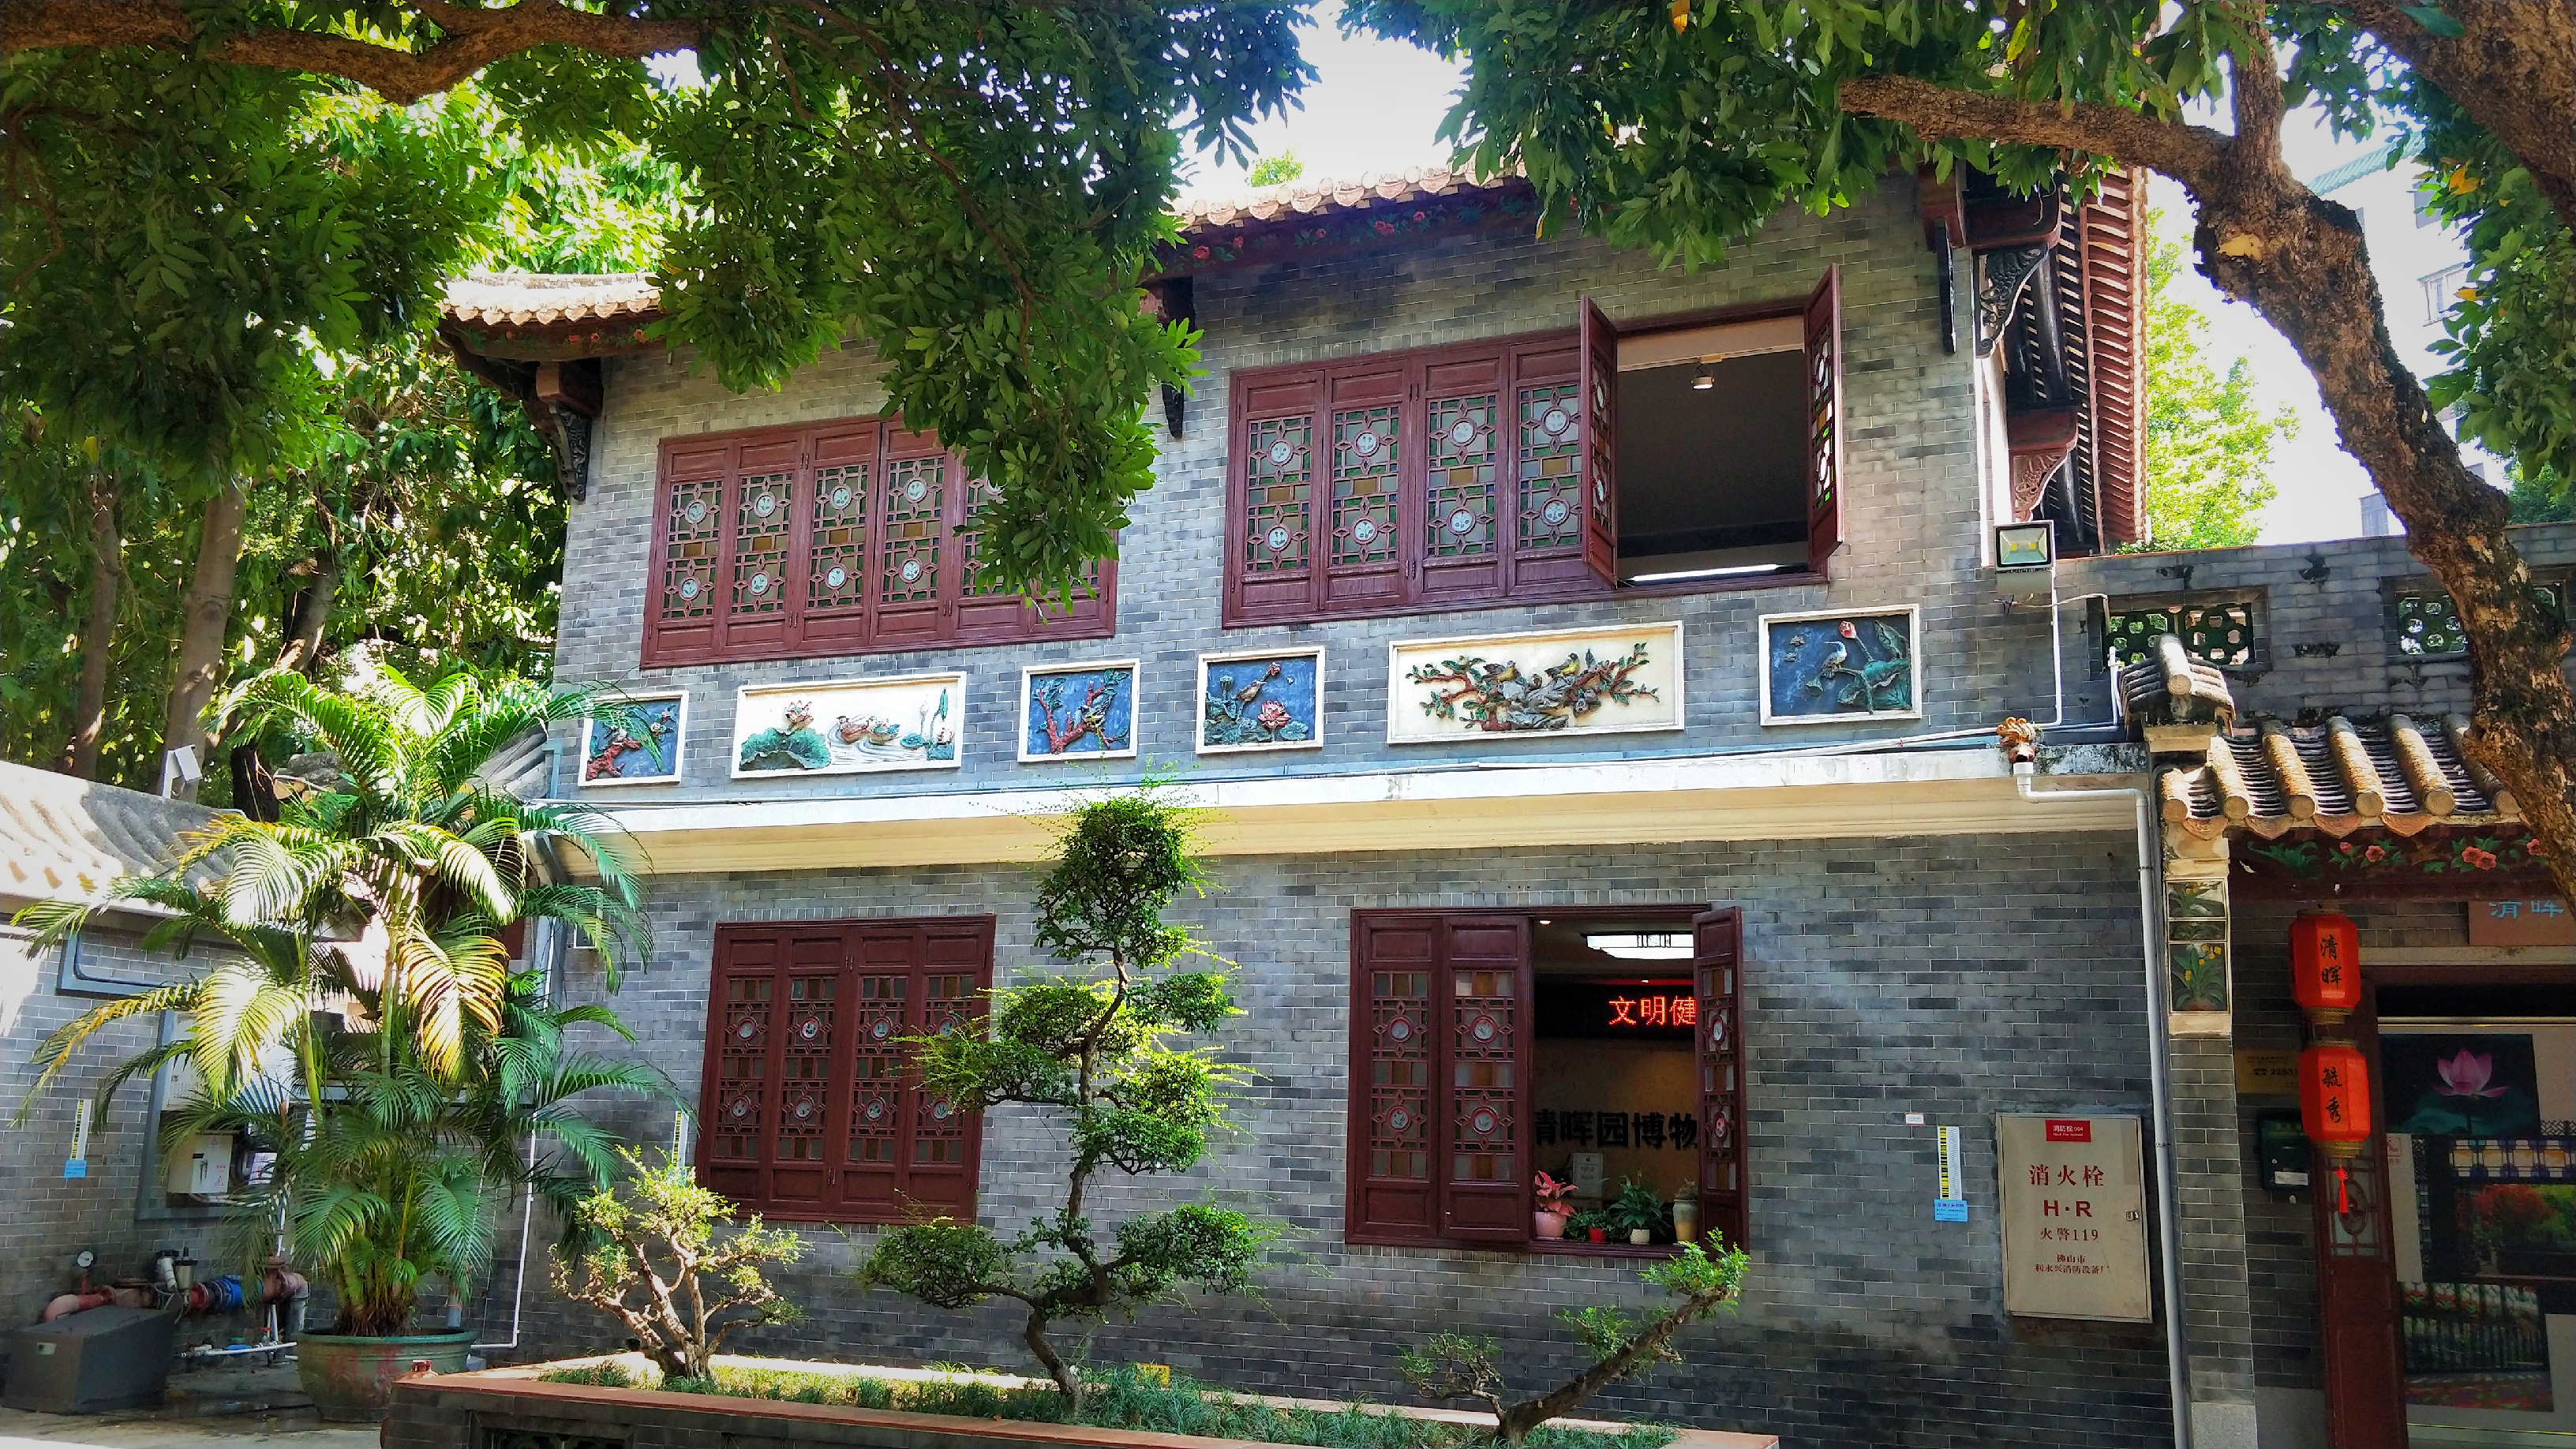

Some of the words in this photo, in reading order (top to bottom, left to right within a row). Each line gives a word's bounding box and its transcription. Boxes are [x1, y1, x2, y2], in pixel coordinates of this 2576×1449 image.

[1609, 995, 1696, 1025] 文明健
[2028, 1164, 2104, 1187] 消火栓
[2057, 1254, 2086, 1264] 佛山市
